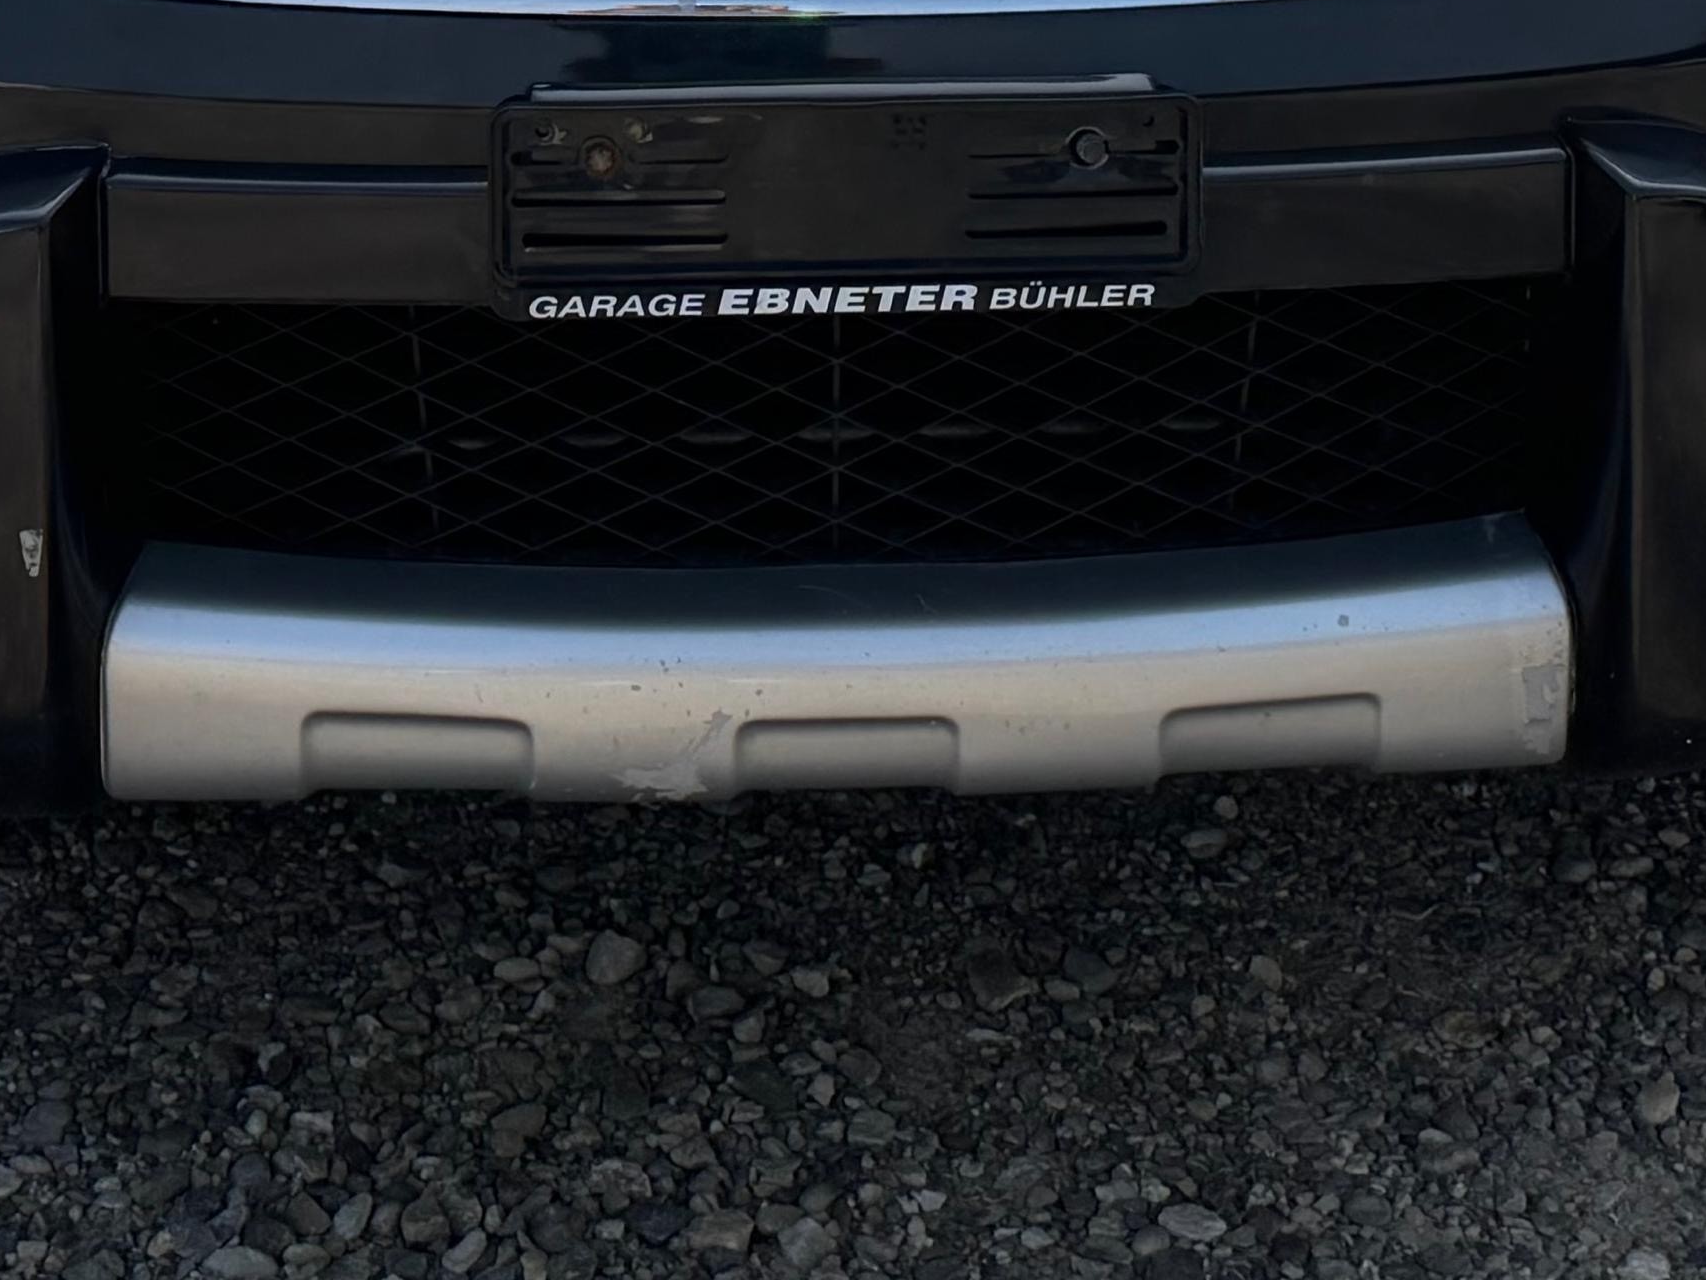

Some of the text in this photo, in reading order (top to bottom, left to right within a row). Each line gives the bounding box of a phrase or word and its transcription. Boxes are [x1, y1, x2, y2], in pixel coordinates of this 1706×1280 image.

[528, 280, 1156, 319] GARAGE EBNETER BÜHLER
